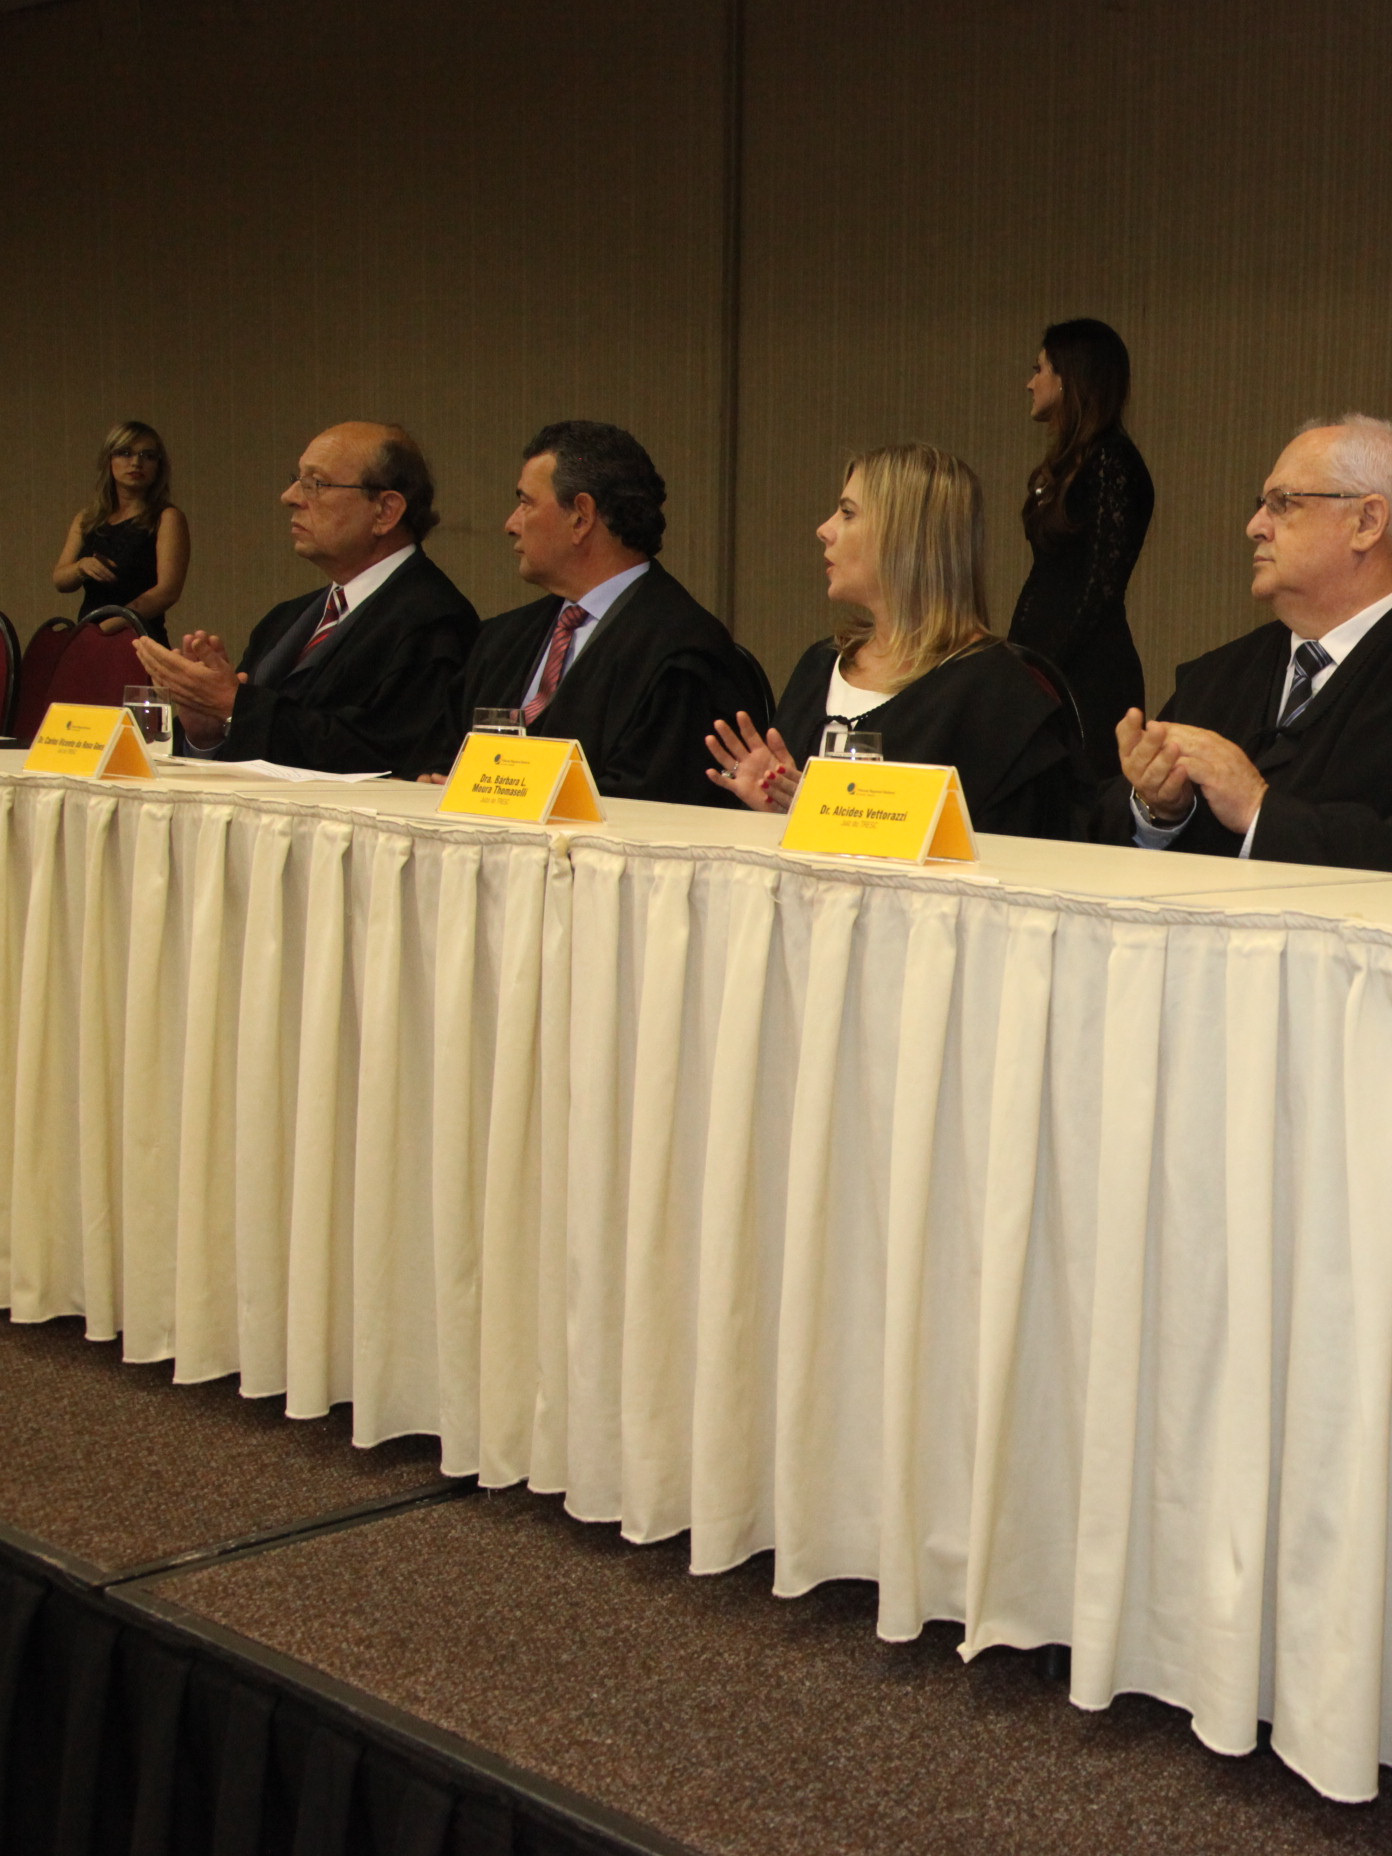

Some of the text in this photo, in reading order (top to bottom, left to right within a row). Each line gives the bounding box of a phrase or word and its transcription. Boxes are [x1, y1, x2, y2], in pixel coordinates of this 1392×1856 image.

[480, 773, 492, 784] Dra.
[520, 777, 527, 787] L.
[472, 783, 529, 797] Moura Thomaselli
[819, 804, 908, 822] Dr. Alcides Vettorazzi
